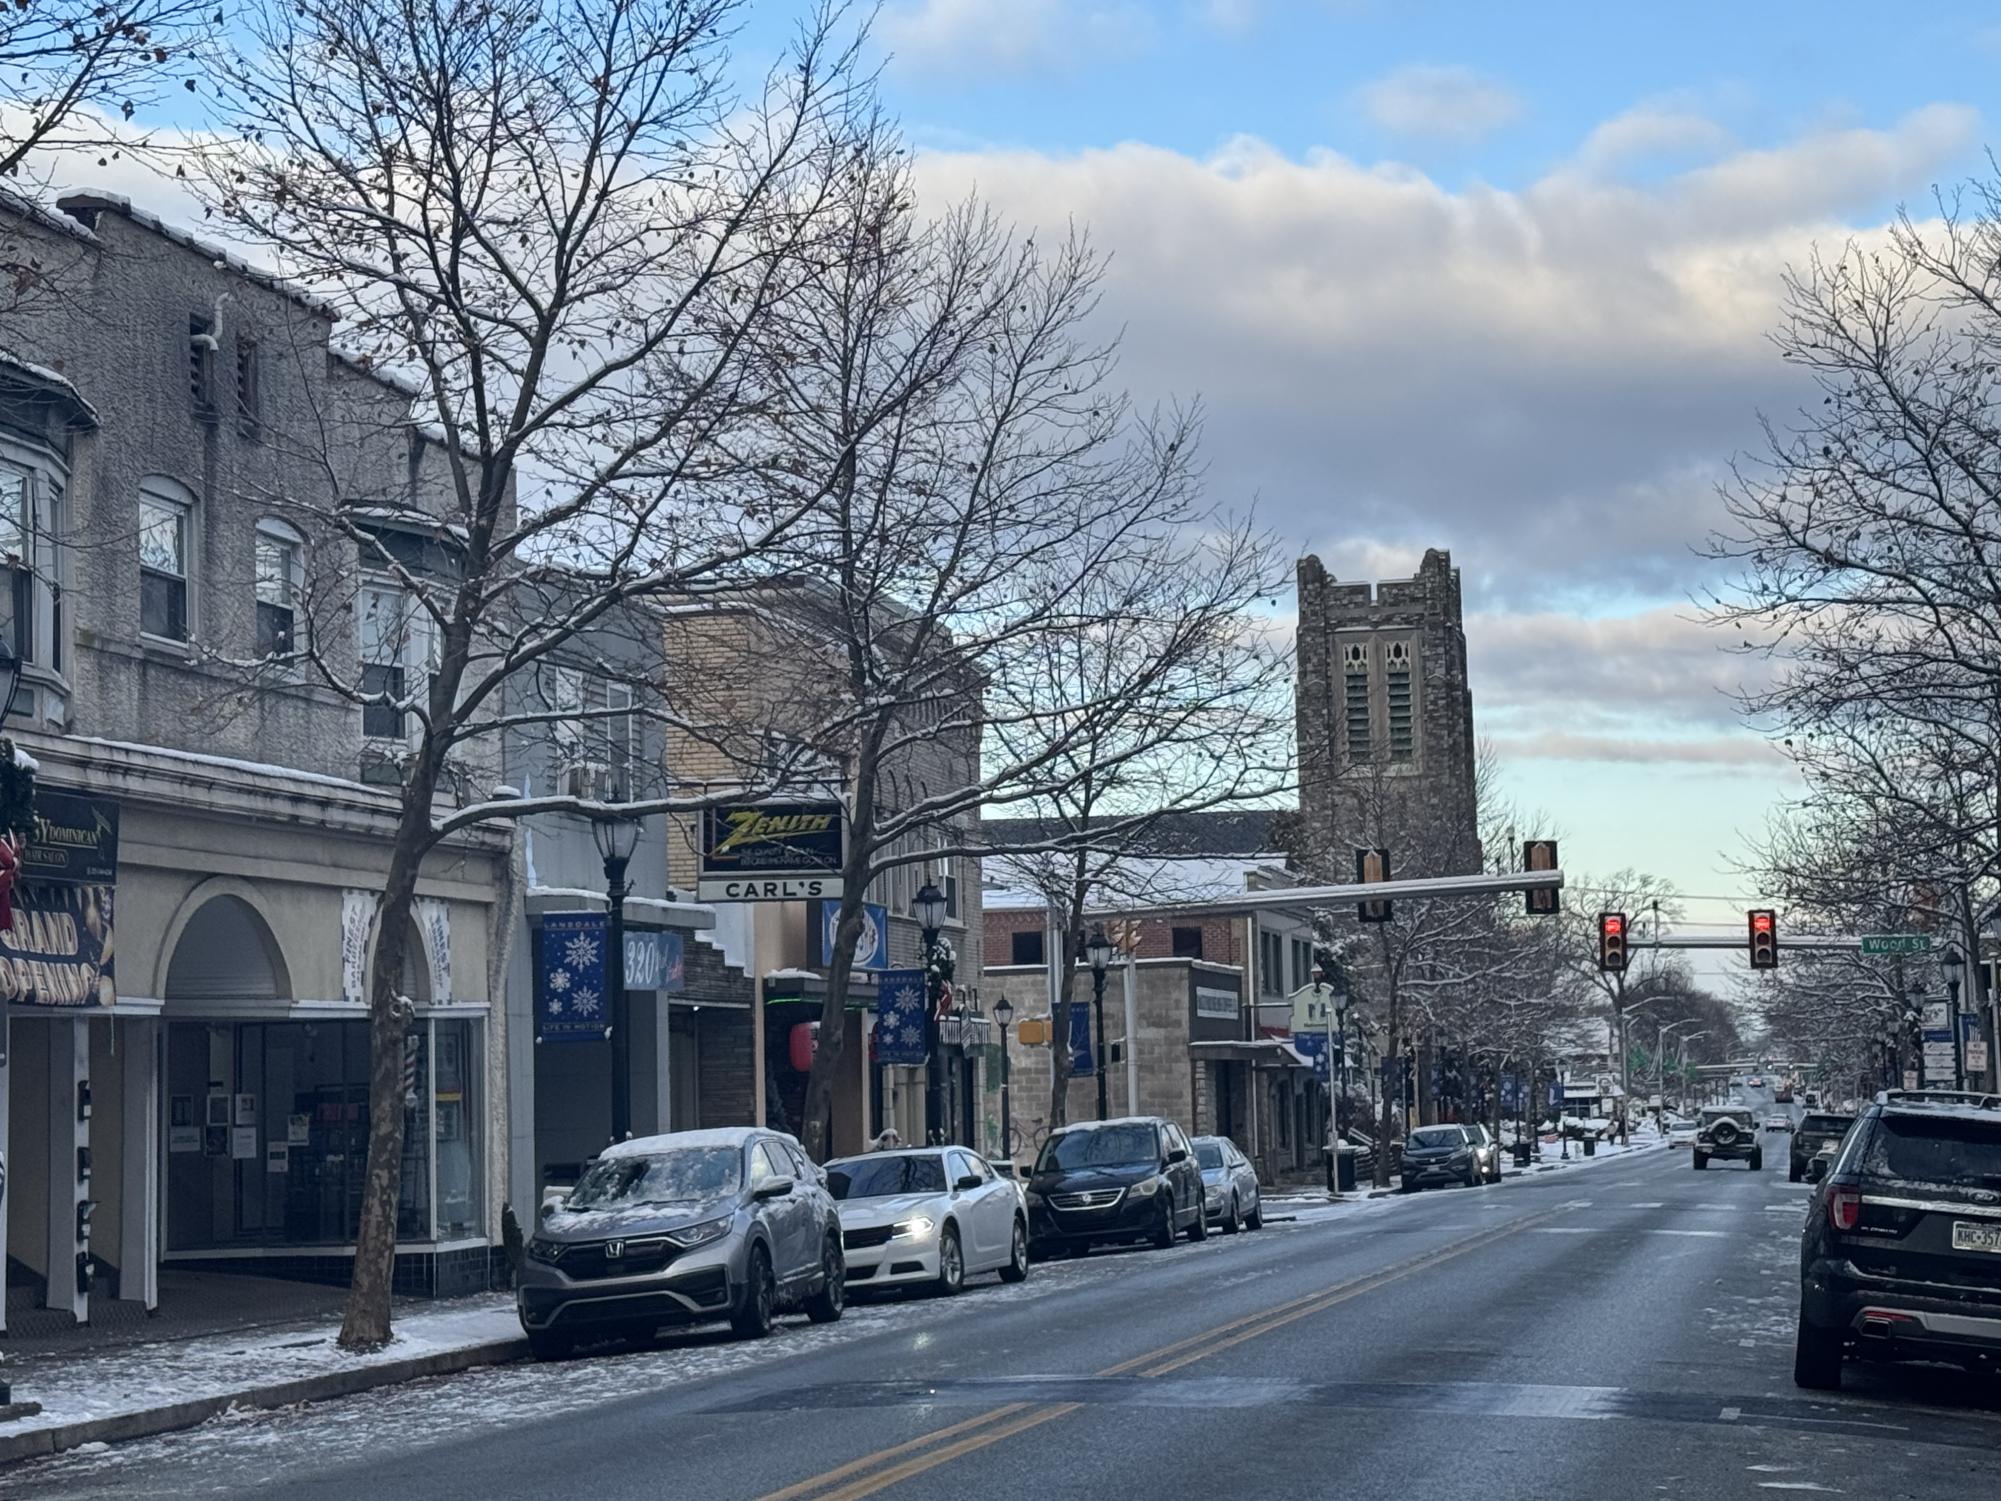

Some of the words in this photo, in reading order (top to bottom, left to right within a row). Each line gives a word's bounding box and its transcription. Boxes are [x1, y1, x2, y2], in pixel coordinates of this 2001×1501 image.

[49, 825, 98, 845] DOMINICAN
[715, 811, 832, 854] ZENITH
[725, 881, 823, 898] CARL'S
[543, 920, 605, 929] LANSDALE
[1868, 938, 1906, 951] Wood
[1911, 938, 1926, 950] St
[625, 941, 655, 984] 320
[0, 956, 96, 1006] OPENING
